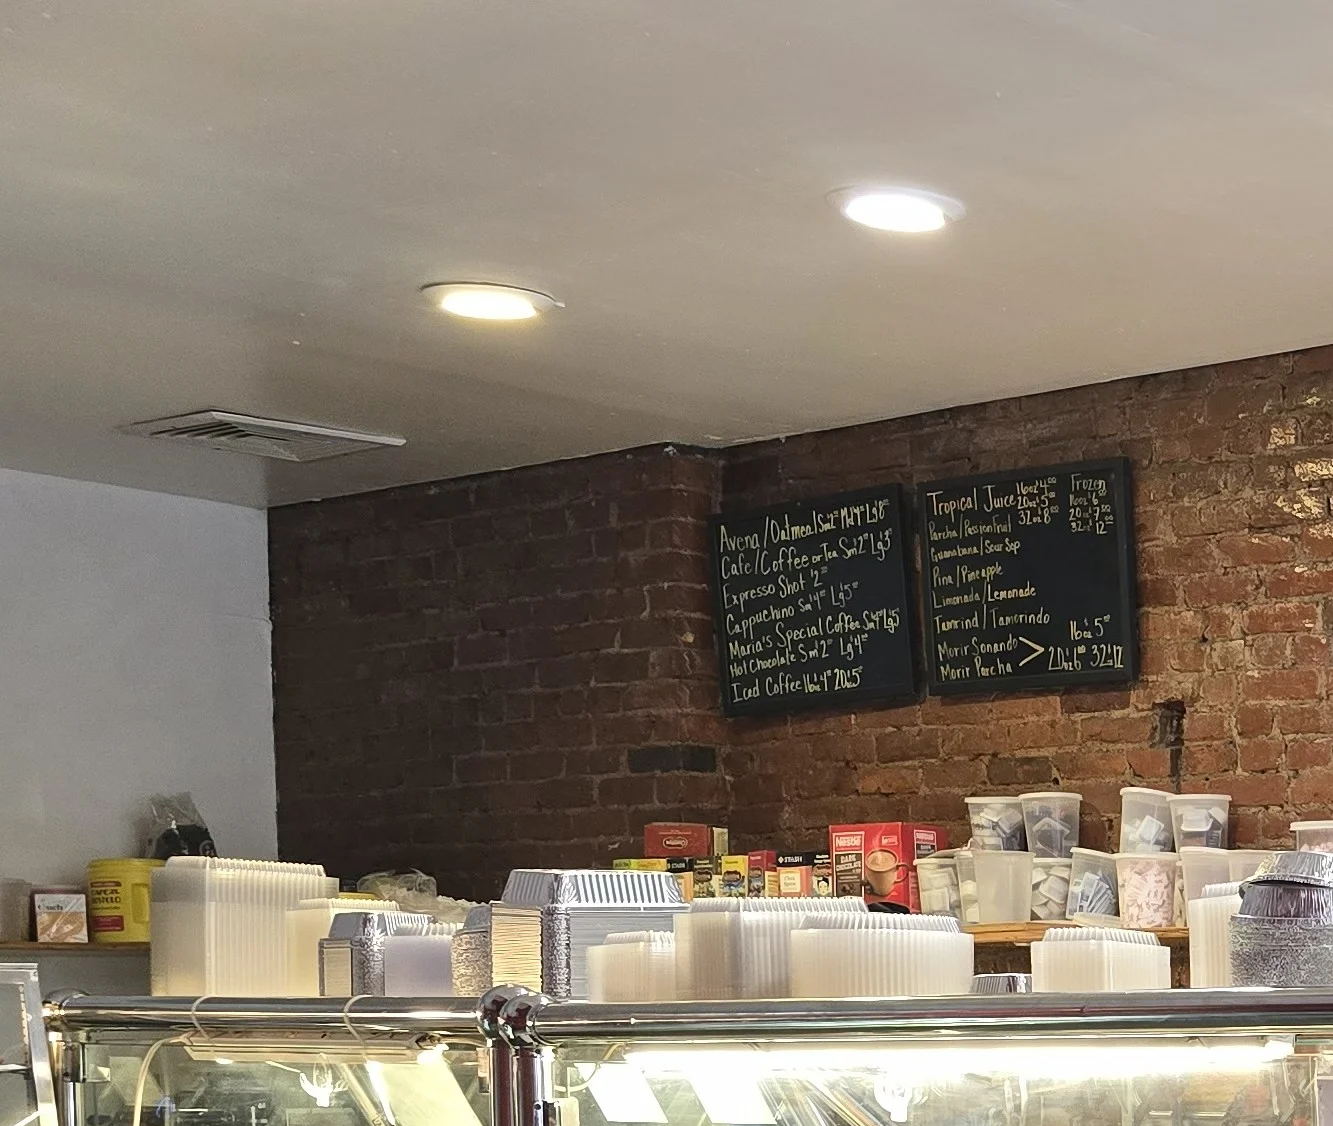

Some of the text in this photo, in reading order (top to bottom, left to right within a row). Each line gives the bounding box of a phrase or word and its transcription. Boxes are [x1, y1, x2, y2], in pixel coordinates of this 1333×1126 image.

[927, 473, 1106, 522] Tropical Juice Frozen
[723, 573, 806, 613] Expresso Shot
[776, 622, 823, 651] Special
[826, 612, 861, 634] Coffee
[730, 647, 797, 677] Hot Chocolate
[731, 672, 803, 703] Iced Coffee
